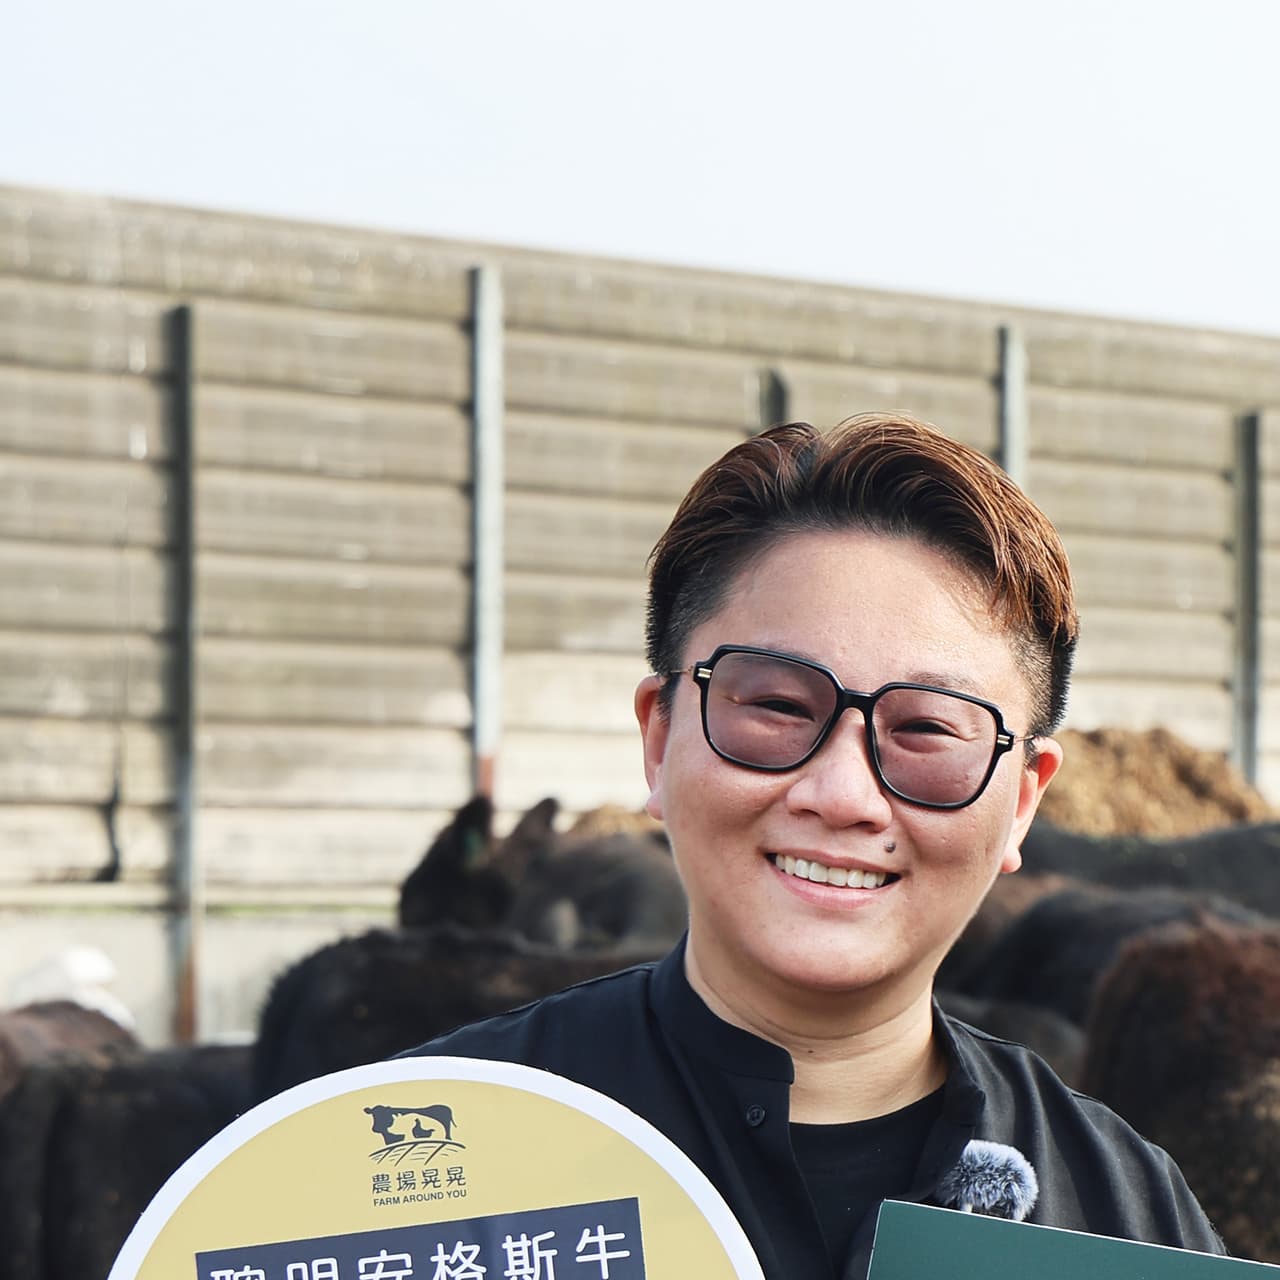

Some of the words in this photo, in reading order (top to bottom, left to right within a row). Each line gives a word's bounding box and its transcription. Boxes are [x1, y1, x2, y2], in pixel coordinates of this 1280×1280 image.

[372, 1166, 466, 1194] 農場晃晃
[373, 1197, 400, 1207] FARM
[403, 1192, 444, 1204] AROUND
[446, 1189, 467, 1199] YOU
